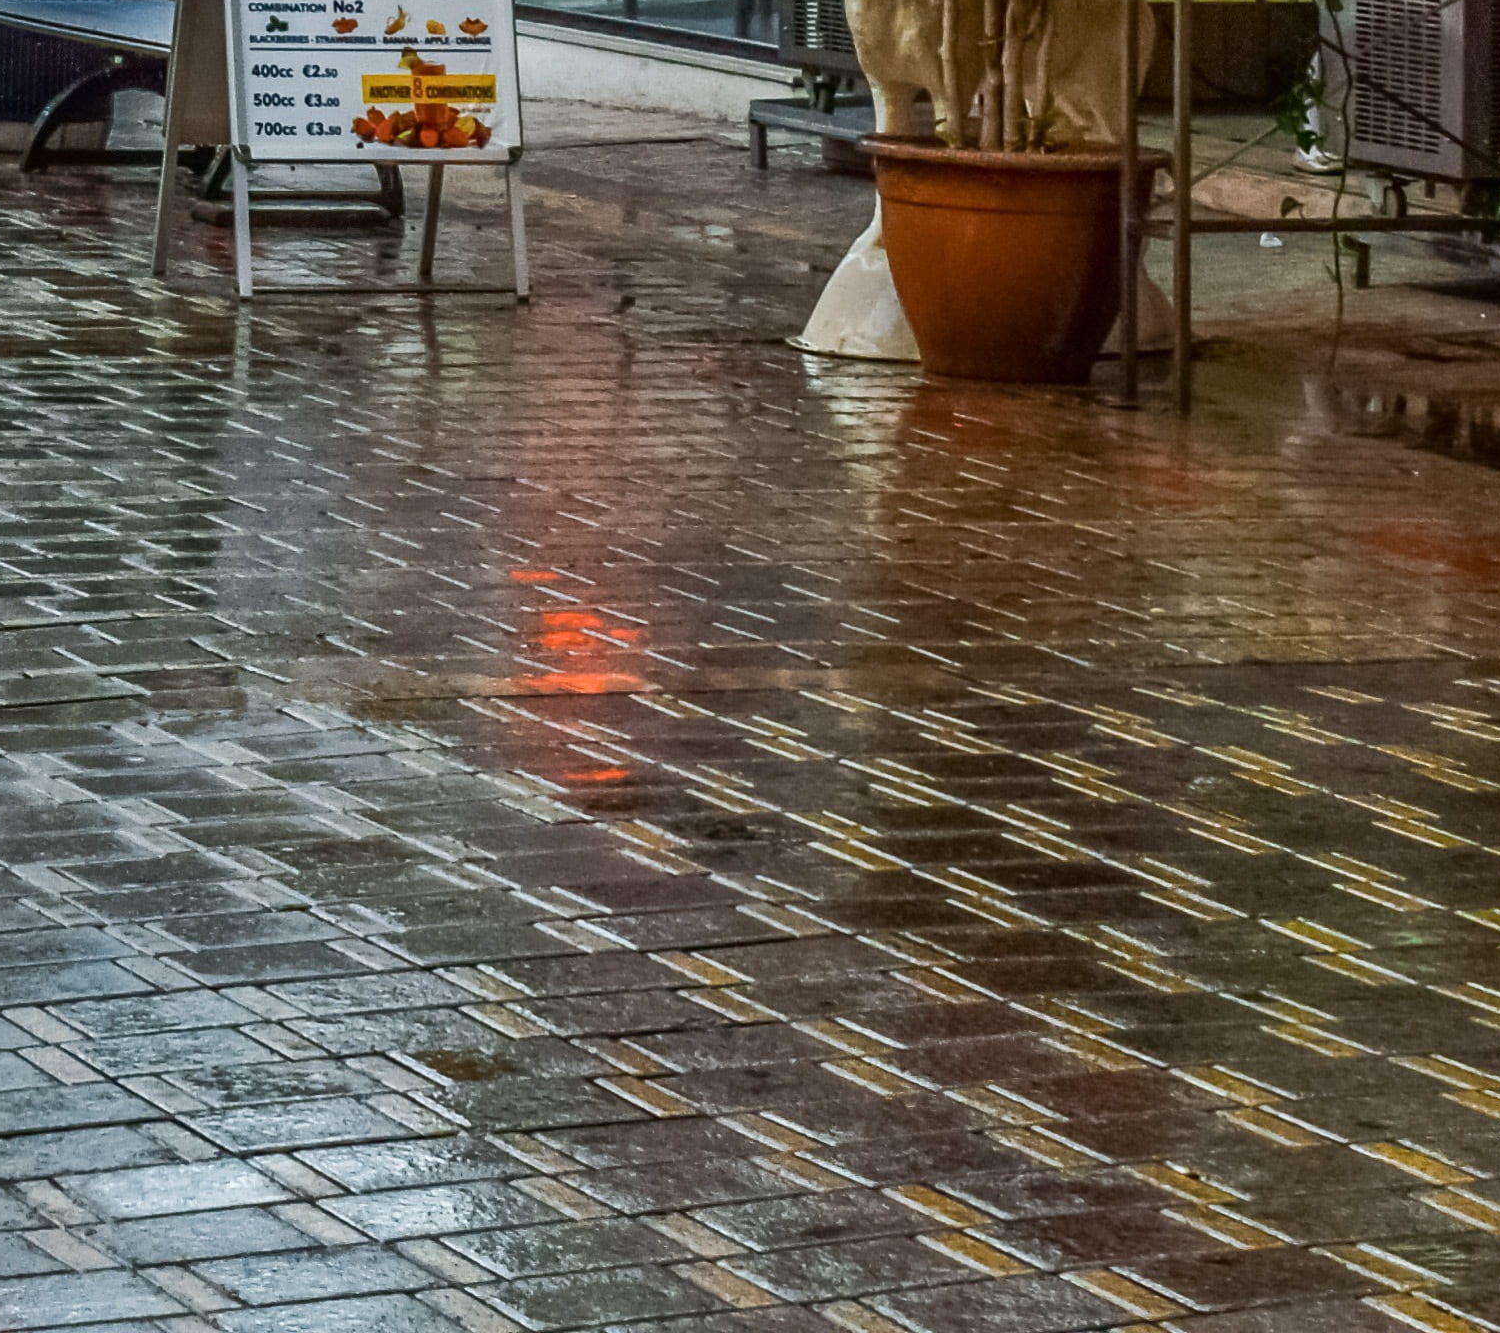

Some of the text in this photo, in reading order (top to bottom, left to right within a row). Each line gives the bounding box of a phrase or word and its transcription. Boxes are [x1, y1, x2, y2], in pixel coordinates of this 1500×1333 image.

[248, 0, 364, 13] COMBINATION No2
[249, 35, 491, 45] BLACKBERRIES STRAWBERRIES BANANA APPLE ORANGE
[251, 64, 338, 78] 400cc €2.50
[369, 86, 411, 99] ANOTHER
[253, 93, 340, 108] 500cc €3.00
[255, 122, 342, 136] 700cc €3.50
